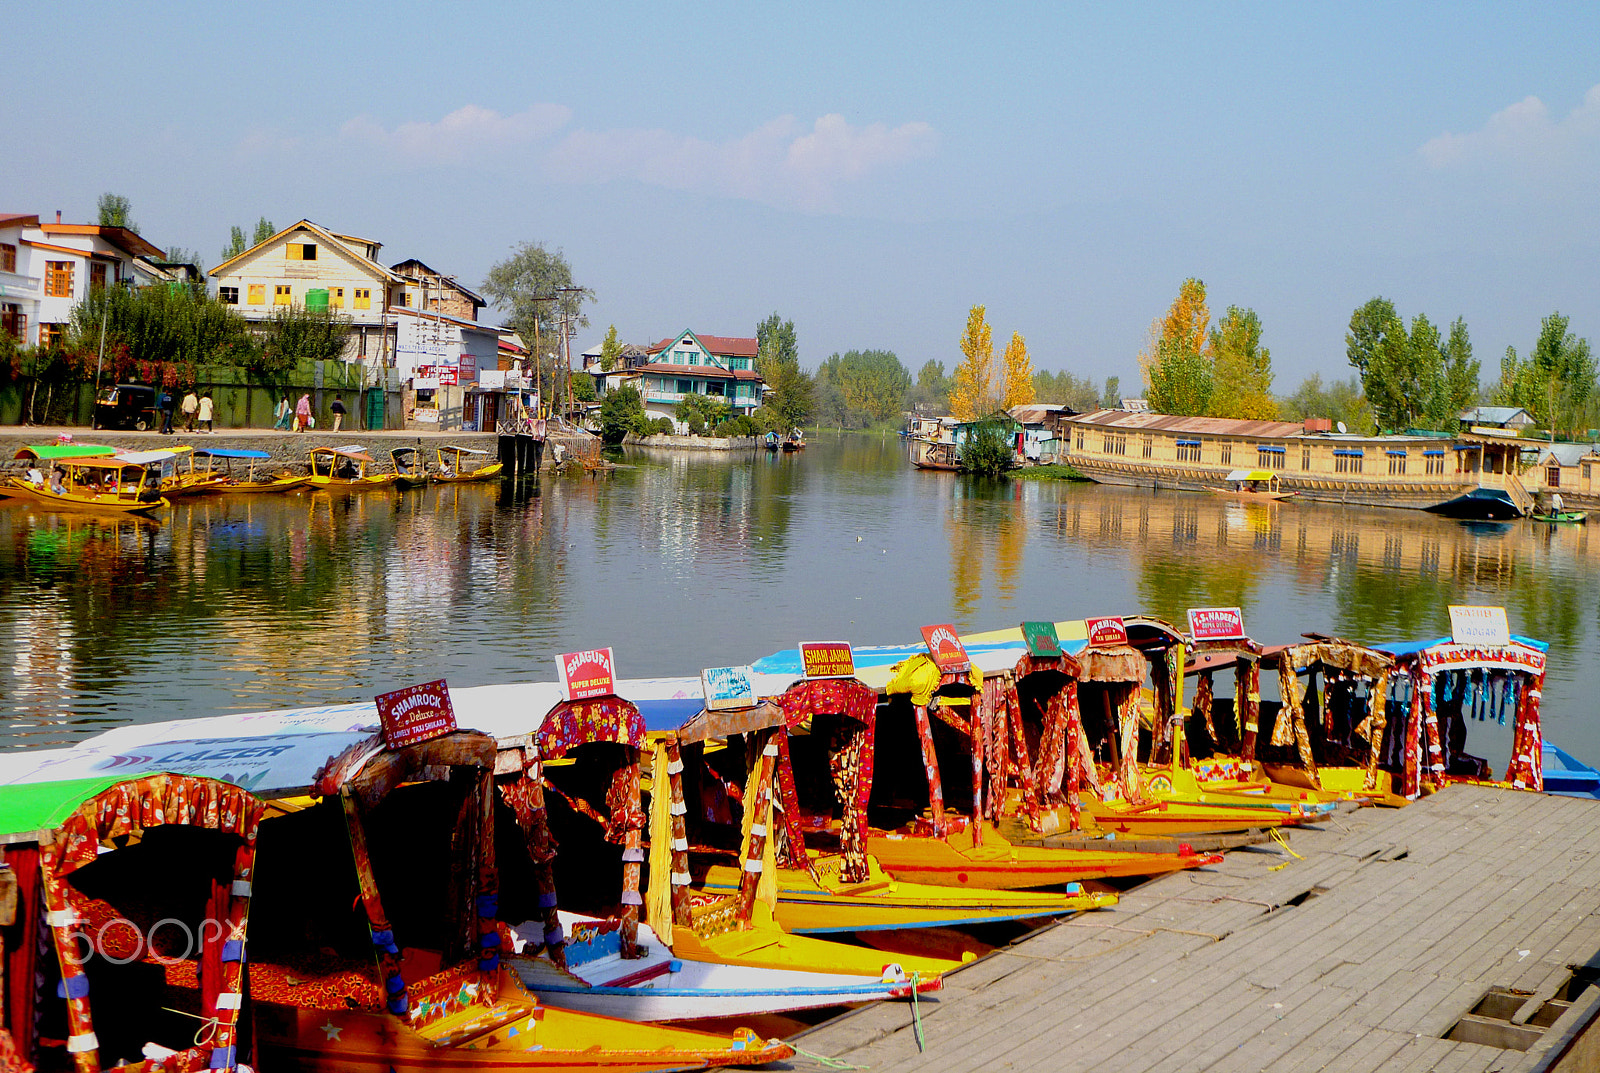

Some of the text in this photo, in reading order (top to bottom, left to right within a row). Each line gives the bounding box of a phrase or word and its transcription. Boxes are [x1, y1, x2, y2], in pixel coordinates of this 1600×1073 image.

[566, 650, 610, 677] SHAGUFA
[829, 649, 851, 662] JAHAN
[806, 664, 831, 675] LOVELY
[571, 676, 610, 689] SUPER DELUXE
[391, 693, 442, 721] SHAMROCK
[409, 709, 434, 723] Deluxe
[393, 718, 447, 739] LOVELY TAXI SHIKARA
[153, 744, 296, 764] LAZER
